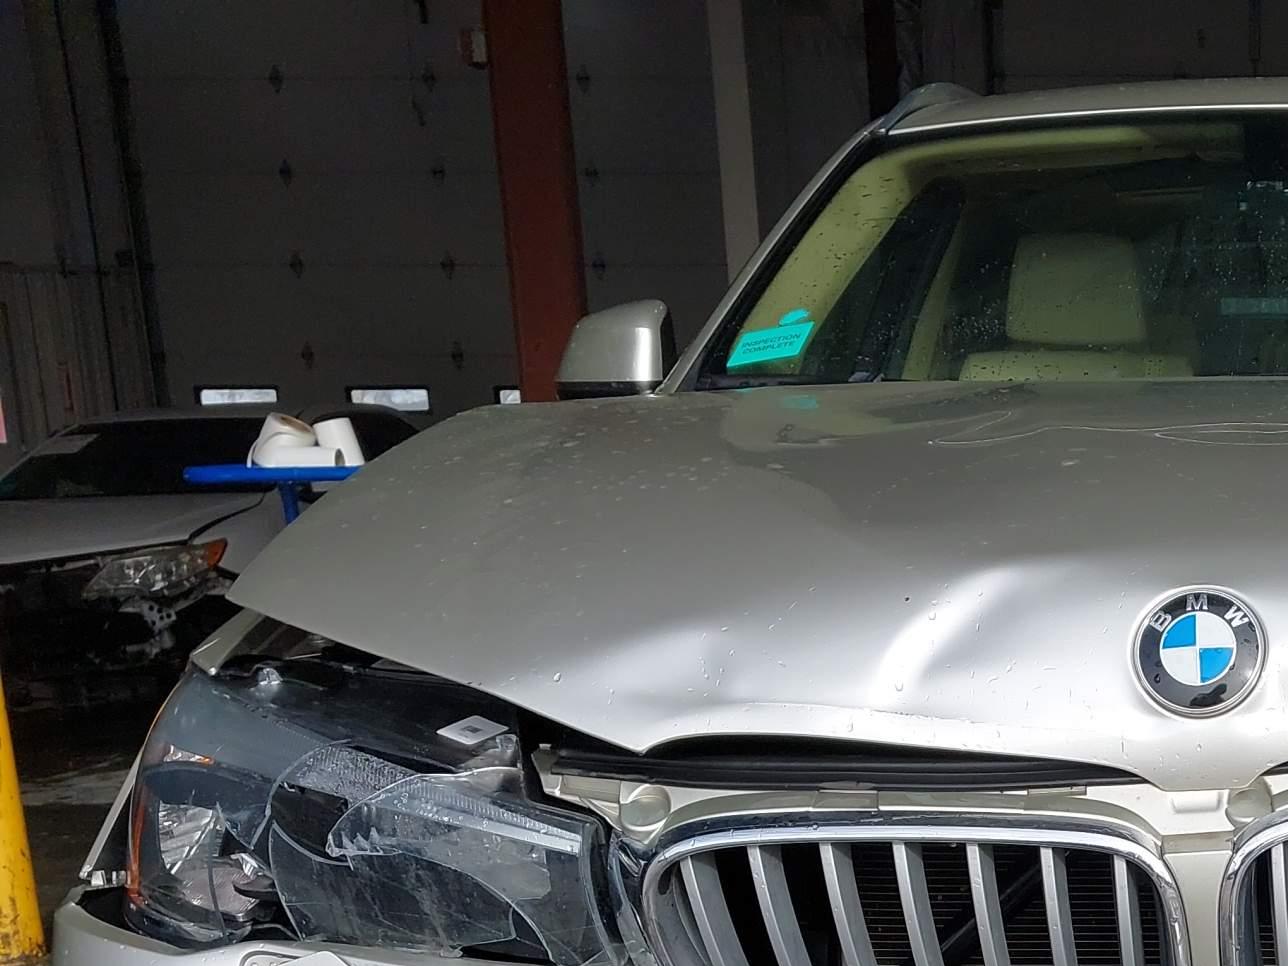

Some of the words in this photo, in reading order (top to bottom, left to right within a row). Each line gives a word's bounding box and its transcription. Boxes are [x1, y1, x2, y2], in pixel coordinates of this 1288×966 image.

[742, 334, 801, 348] INSPECTION
[742, 341, 795, 354] COMPLETE
[1150, 593, 1249, 632] BMW
